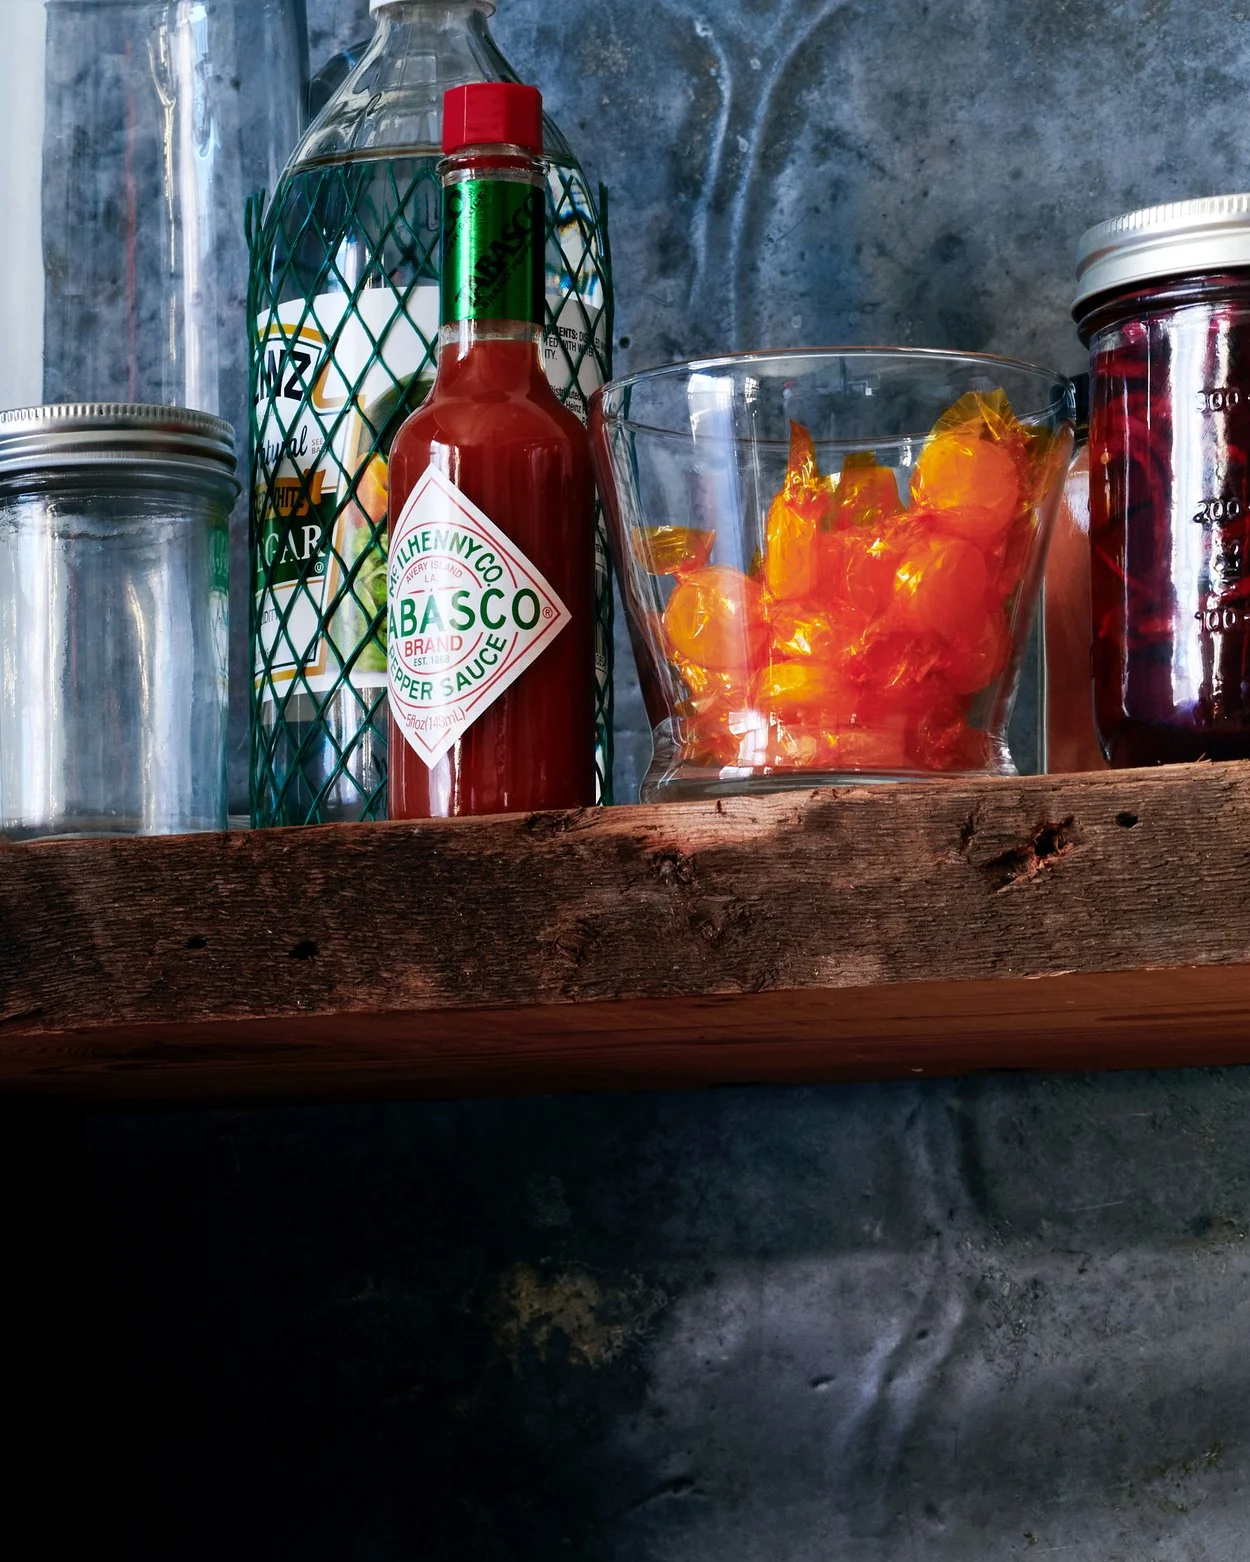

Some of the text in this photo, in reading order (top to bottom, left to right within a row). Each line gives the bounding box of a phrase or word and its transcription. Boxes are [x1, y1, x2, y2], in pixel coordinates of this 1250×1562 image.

[405, 561, 429, 584] AVERY
[404, 635, 463, 657] BRAND
[413, 657, 428, 667] EST.
[440, 633, 508, 697] SAUCE
